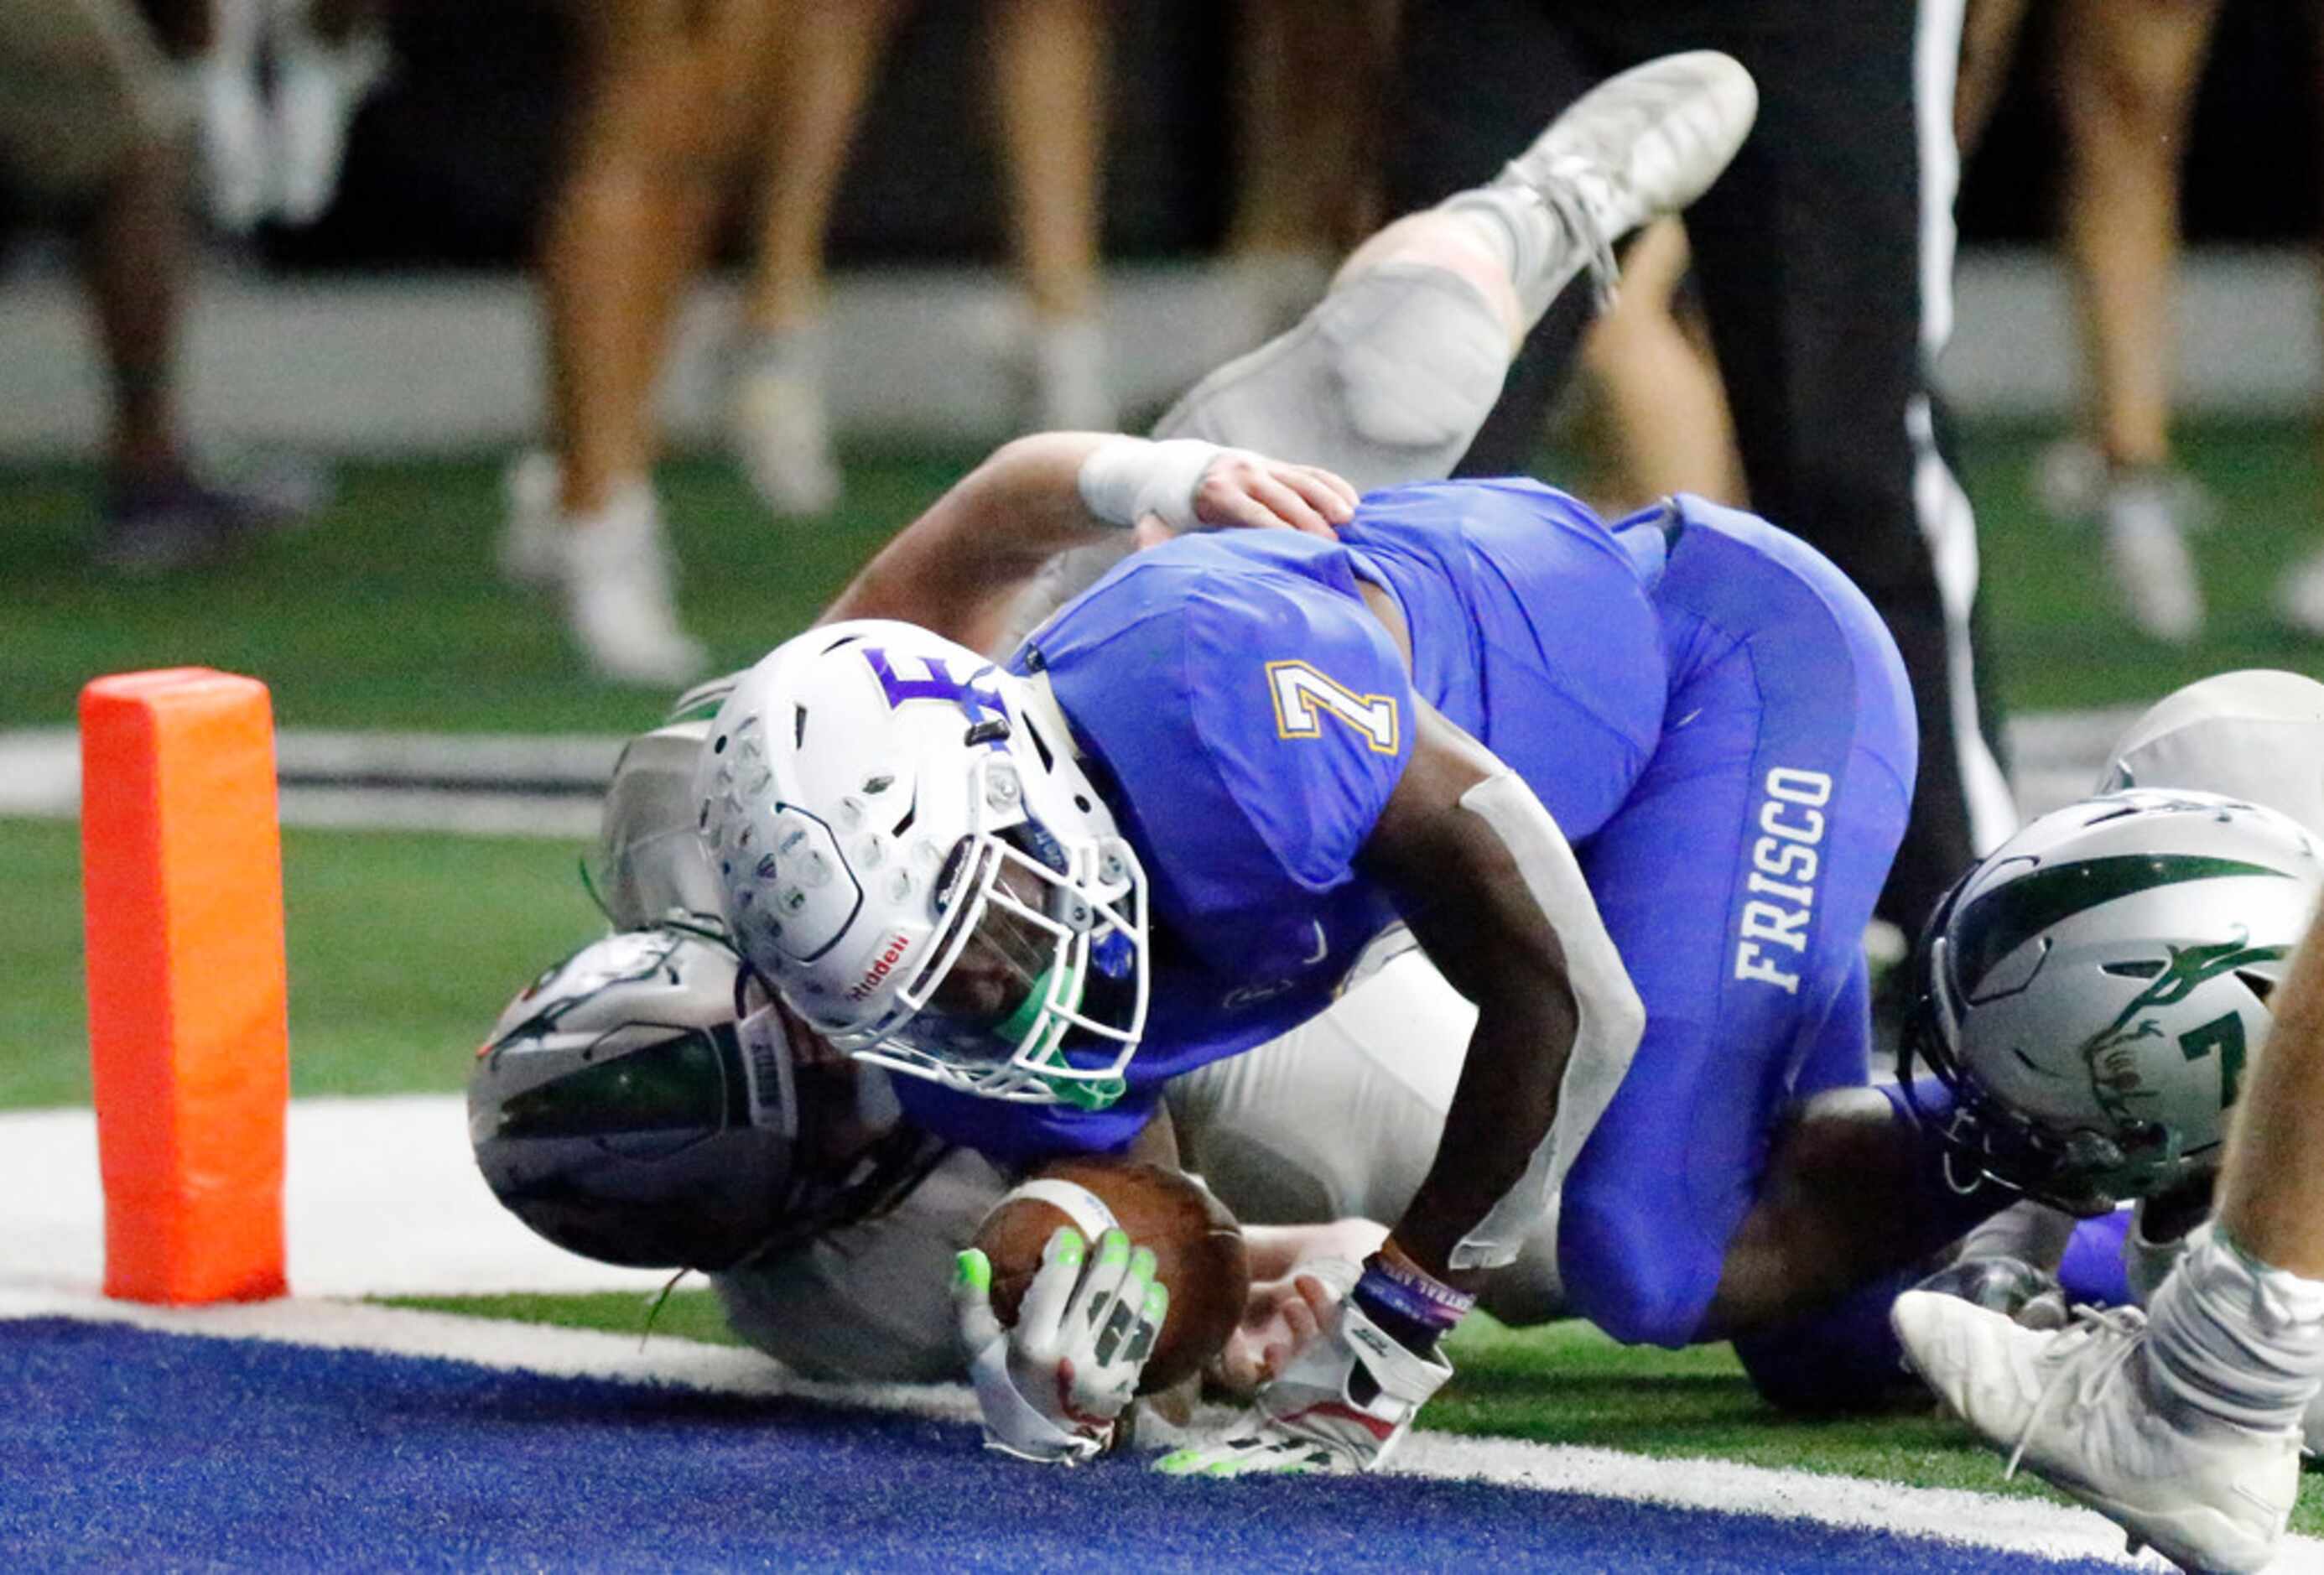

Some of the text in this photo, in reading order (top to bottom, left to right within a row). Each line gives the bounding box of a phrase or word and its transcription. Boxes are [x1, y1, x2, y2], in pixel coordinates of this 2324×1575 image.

[1265, 659, 1399, 756] 7
[1734, 767, 1833, 995] FRISCO
[849, 933, 909, 1002] Riddell
[2178, 1010, 2247, 1110] 7
